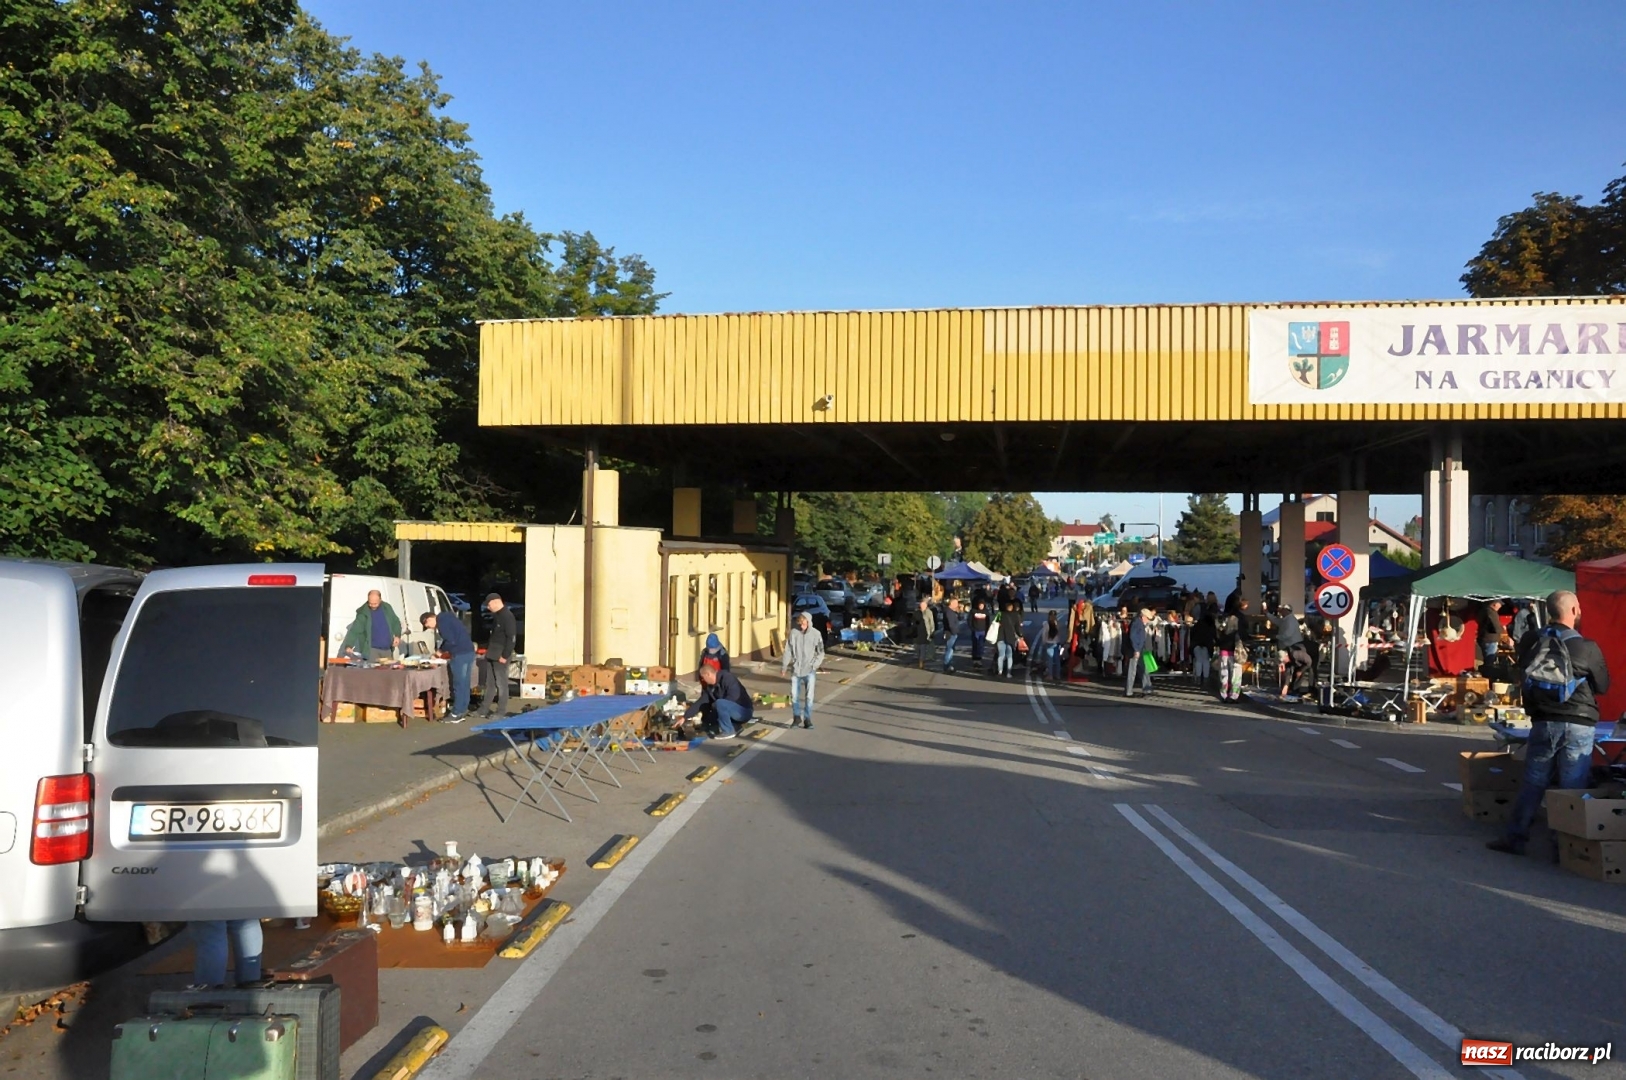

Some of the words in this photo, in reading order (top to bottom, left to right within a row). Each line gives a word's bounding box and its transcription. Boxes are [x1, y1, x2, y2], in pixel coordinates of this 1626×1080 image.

[1387, 322, 1626, 356] JARMAR
[1415, 370, 1459, 390] NA
[1480, 369, 1616, 390] GRANICY
[1321, 591, 1349, 609] 20
[111, 866, 159, 875] CADDY
